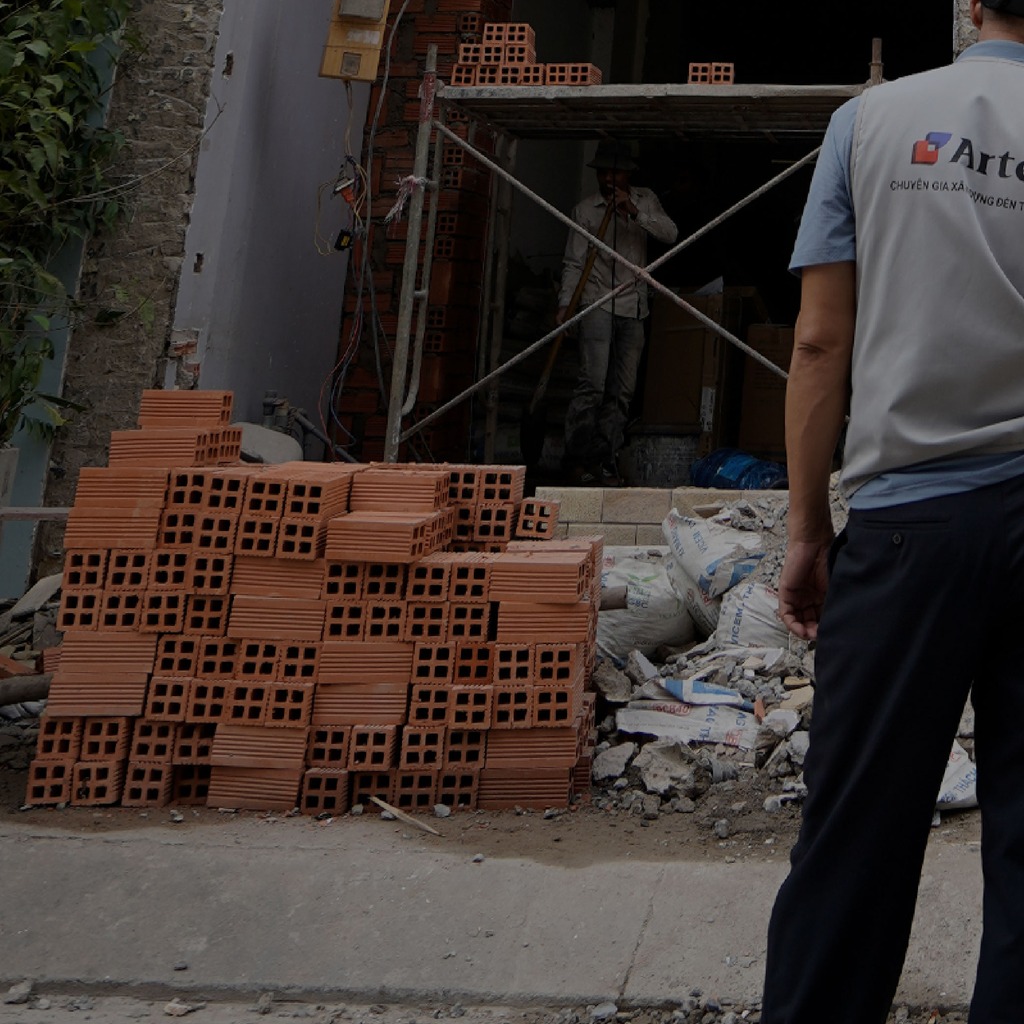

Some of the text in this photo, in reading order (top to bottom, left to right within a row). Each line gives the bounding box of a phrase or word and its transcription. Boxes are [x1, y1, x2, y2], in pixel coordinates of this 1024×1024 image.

[890, 177, 929, 191] CHUYÊN
[931, 180, 949, 191] GIA
[950, 179, 967, 192] XÂ
[730, 608, 744, 645] VICEM
